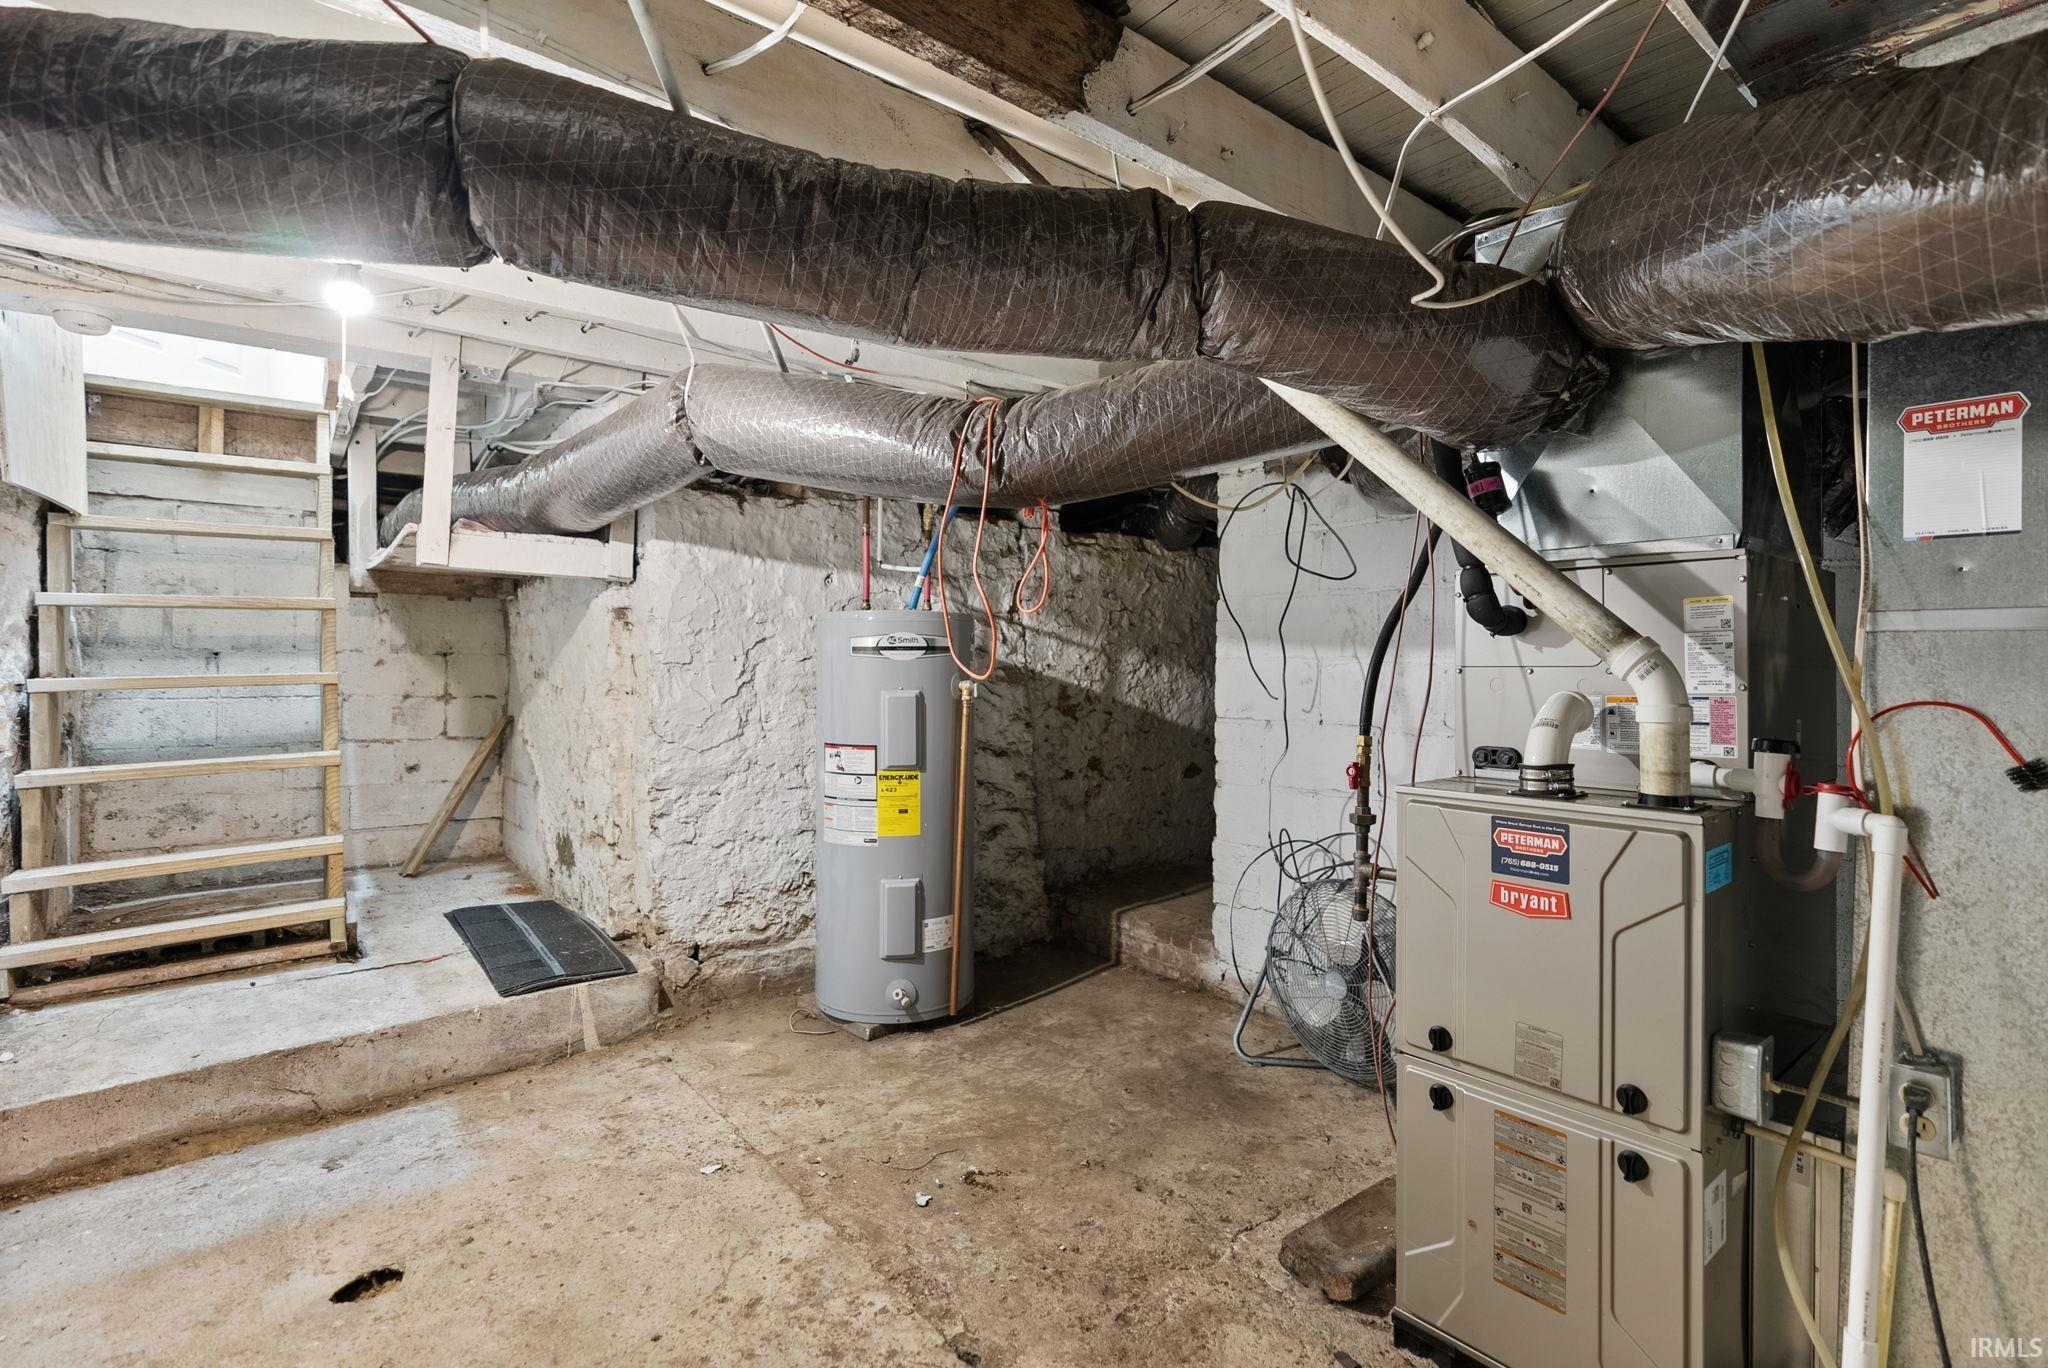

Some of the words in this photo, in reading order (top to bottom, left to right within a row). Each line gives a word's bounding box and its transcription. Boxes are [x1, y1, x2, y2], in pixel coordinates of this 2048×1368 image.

[1912, 400, 2014, 426] PETERMAN
[1936, 419, 1986, 430] BROTHERS
[897, 636, 920, 644] Smith
[1500, 832, 1560, 850] PETERMAN
[1501, 857, 1520, 867] (765)
[1520, 860, 1559, 872] 688-0515
[1500, 886, 1558, 913] bryant
